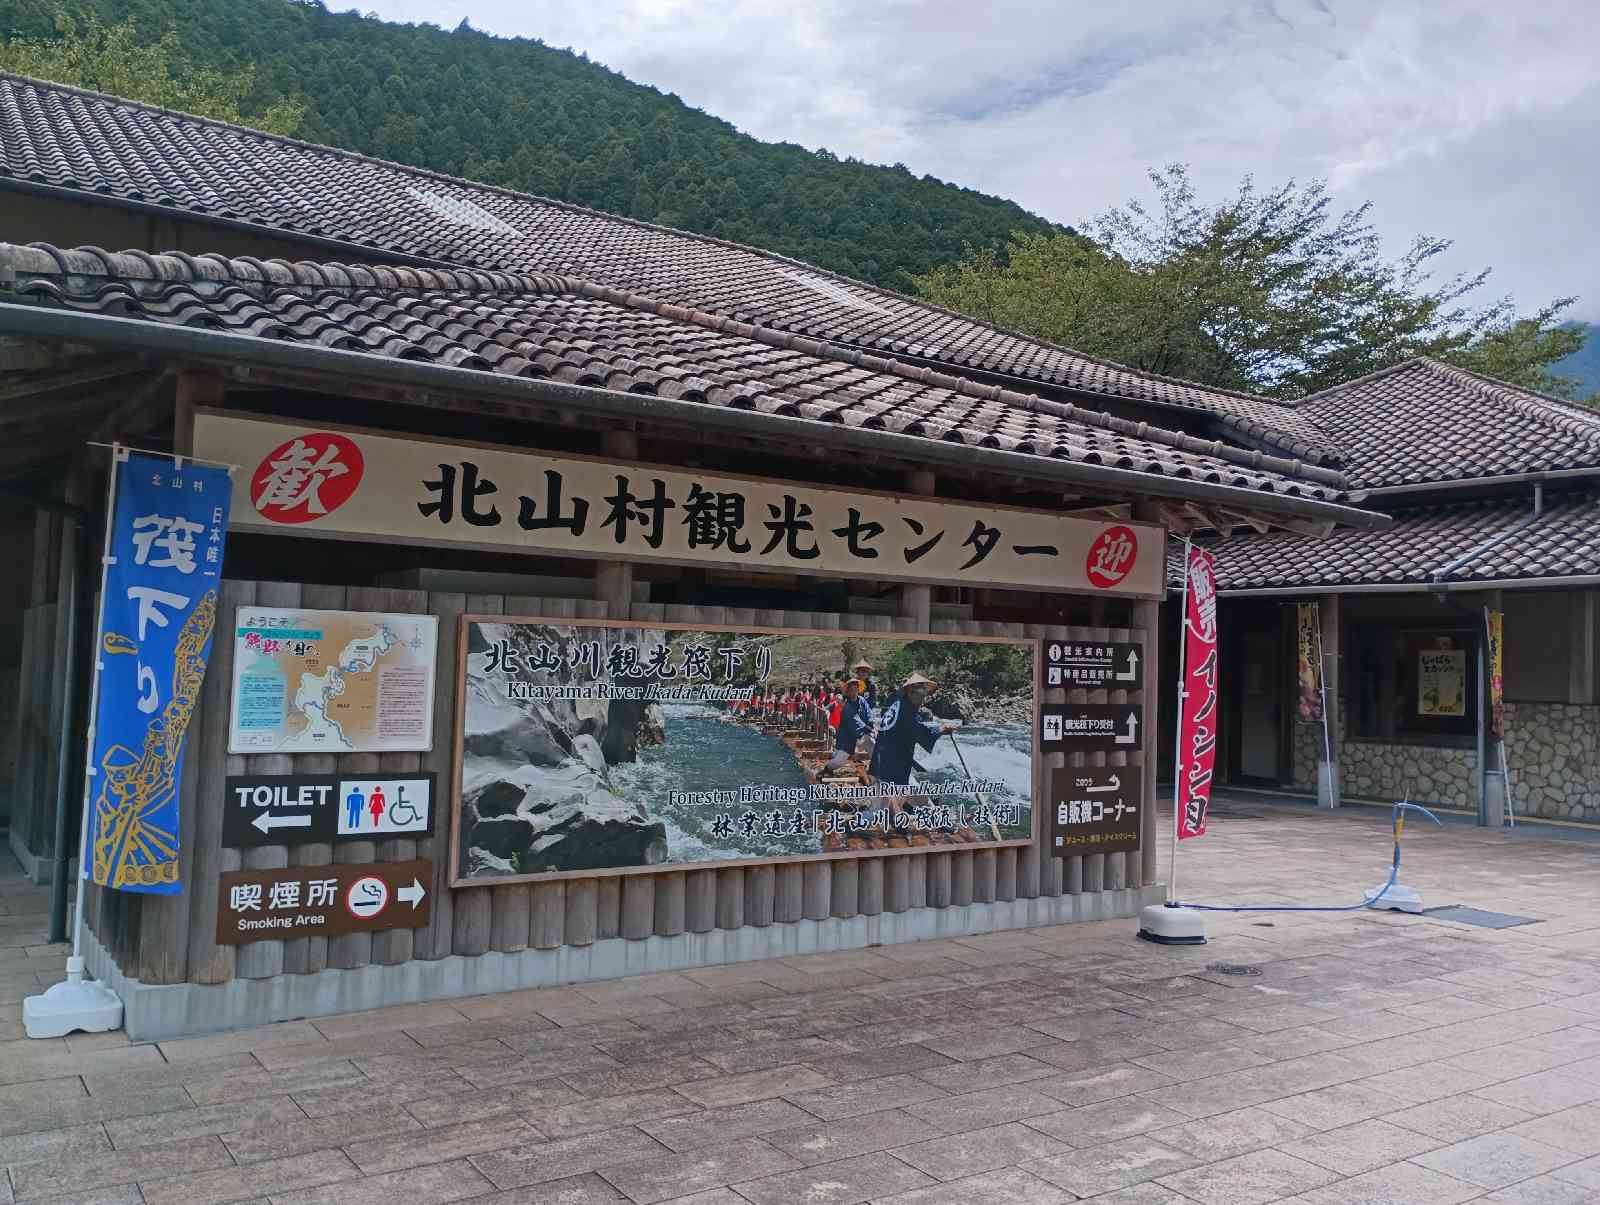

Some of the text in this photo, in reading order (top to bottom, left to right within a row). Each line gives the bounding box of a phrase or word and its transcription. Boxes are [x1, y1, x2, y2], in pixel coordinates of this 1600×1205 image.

[417, 461, 1059, 571] 北山村観光センター
[1090, 534, 1130, 582] 迎
[127, 513, 205, 714] 筏下り
[482, 638, 773, 681] 北山川観光筏下り
[507, 681, 755, 703] Kitayama River Ikada-Kudari
[235, 785, 333, 808] TOILET
[668, 778, 1007, 808] Forestry Heritage Kitayama River Ikada-Kudari
[712, 804, 1021, 839] 林業遺産「北山川の筏流し技術」
[1057, 798, 1137, 825] 自販機コーナー
[230, 878, 339, 912] 喫煙所
[238, 914, 325, 931] Smoking Area
